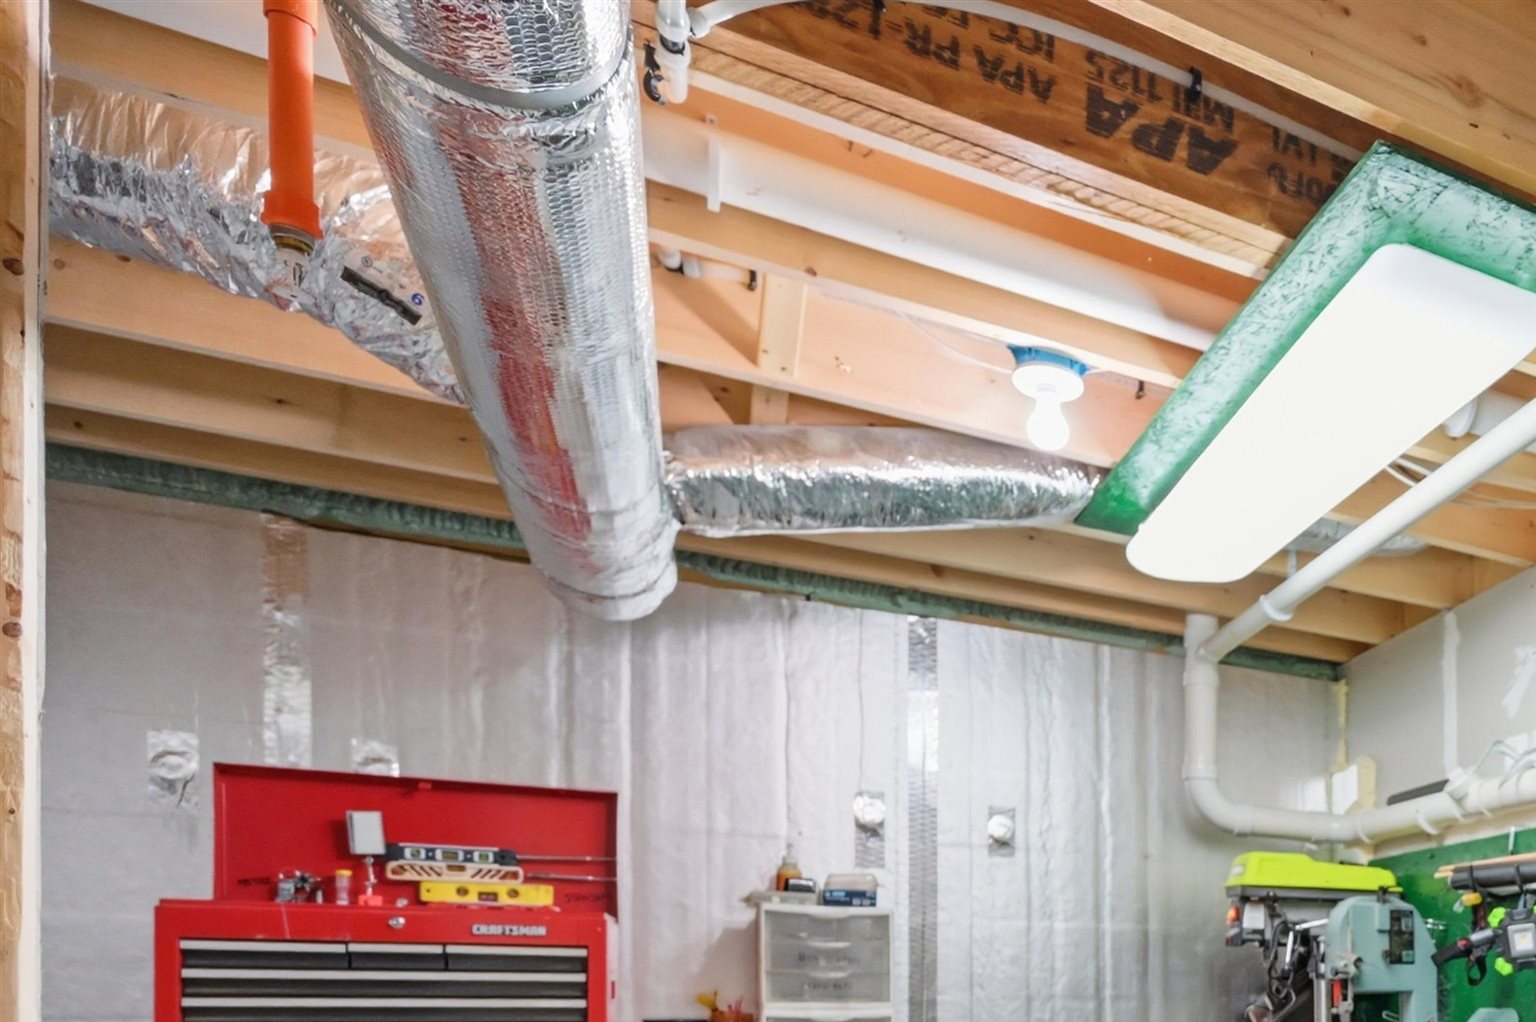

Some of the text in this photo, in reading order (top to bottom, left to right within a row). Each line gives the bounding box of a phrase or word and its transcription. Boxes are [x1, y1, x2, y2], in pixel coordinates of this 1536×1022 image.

[972, 43, 1058, 106] APA
[1085, 48, 1164, 102] 1125
[1085, 83, 1240, 177] APA
[471, 923, 548, 937] CRAFTSMAN
